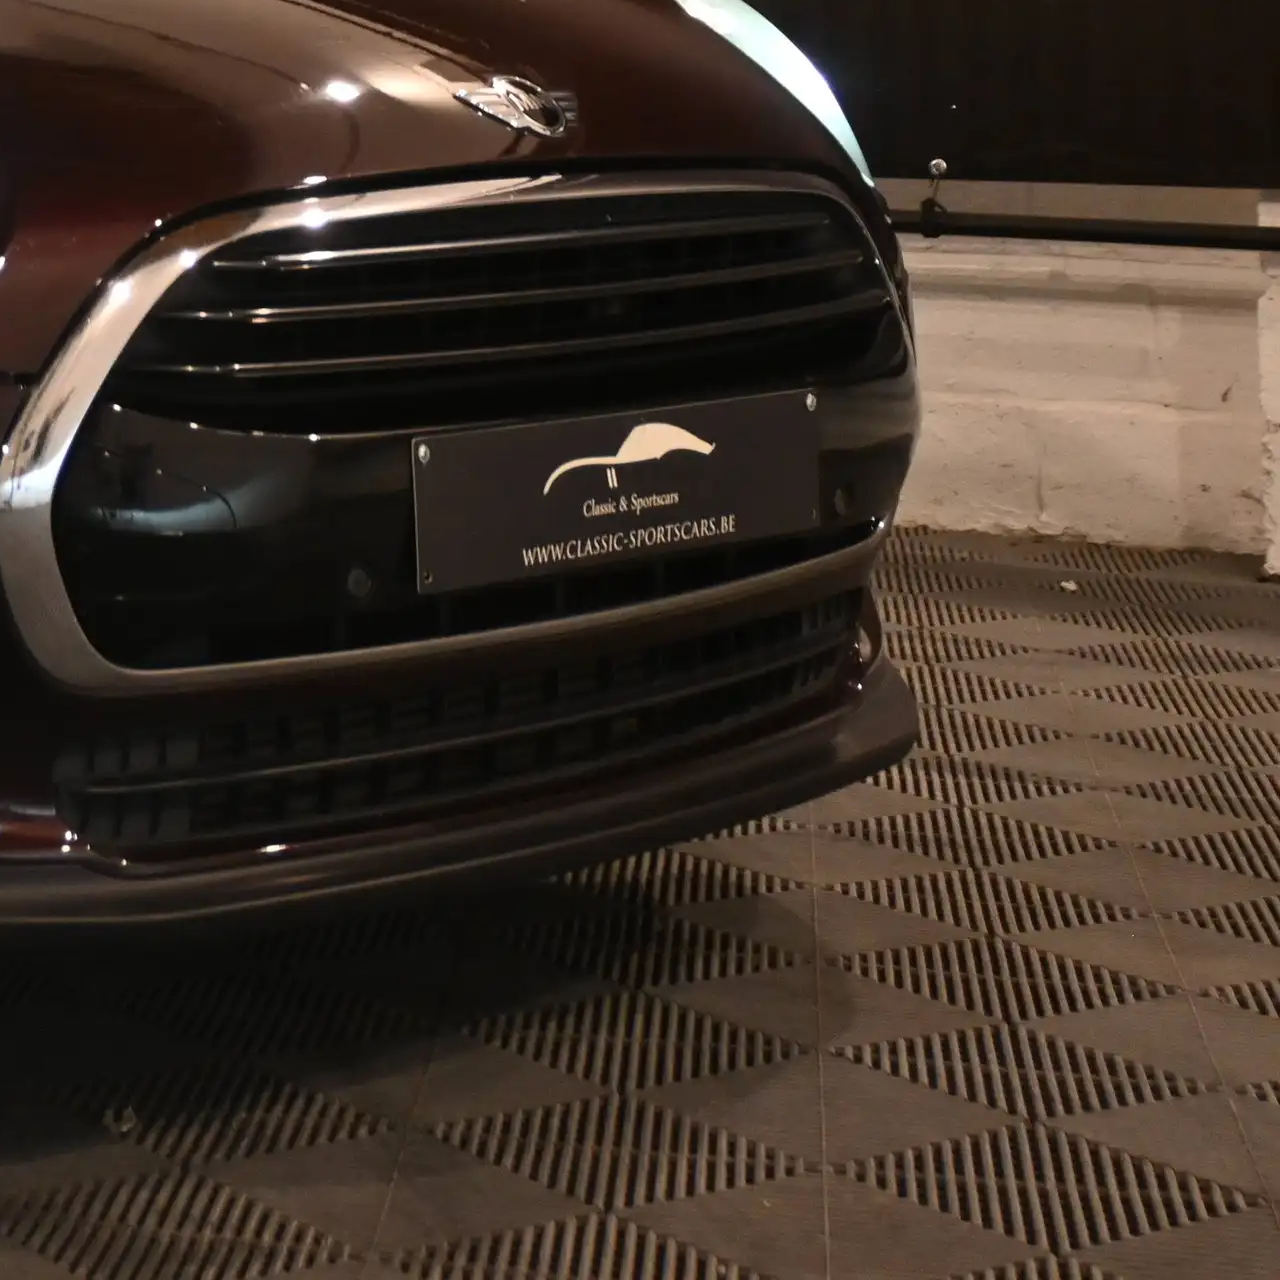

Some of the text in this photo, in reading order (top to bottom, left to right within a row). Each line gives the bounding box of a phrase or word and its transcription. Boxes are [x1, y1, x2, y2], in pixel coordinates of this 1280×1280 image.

[582, 492, 679, 518] Classic & Sportscars
[522, 514, 736, 567] WWW.CLASSIC-SPORTSCARS.BE
